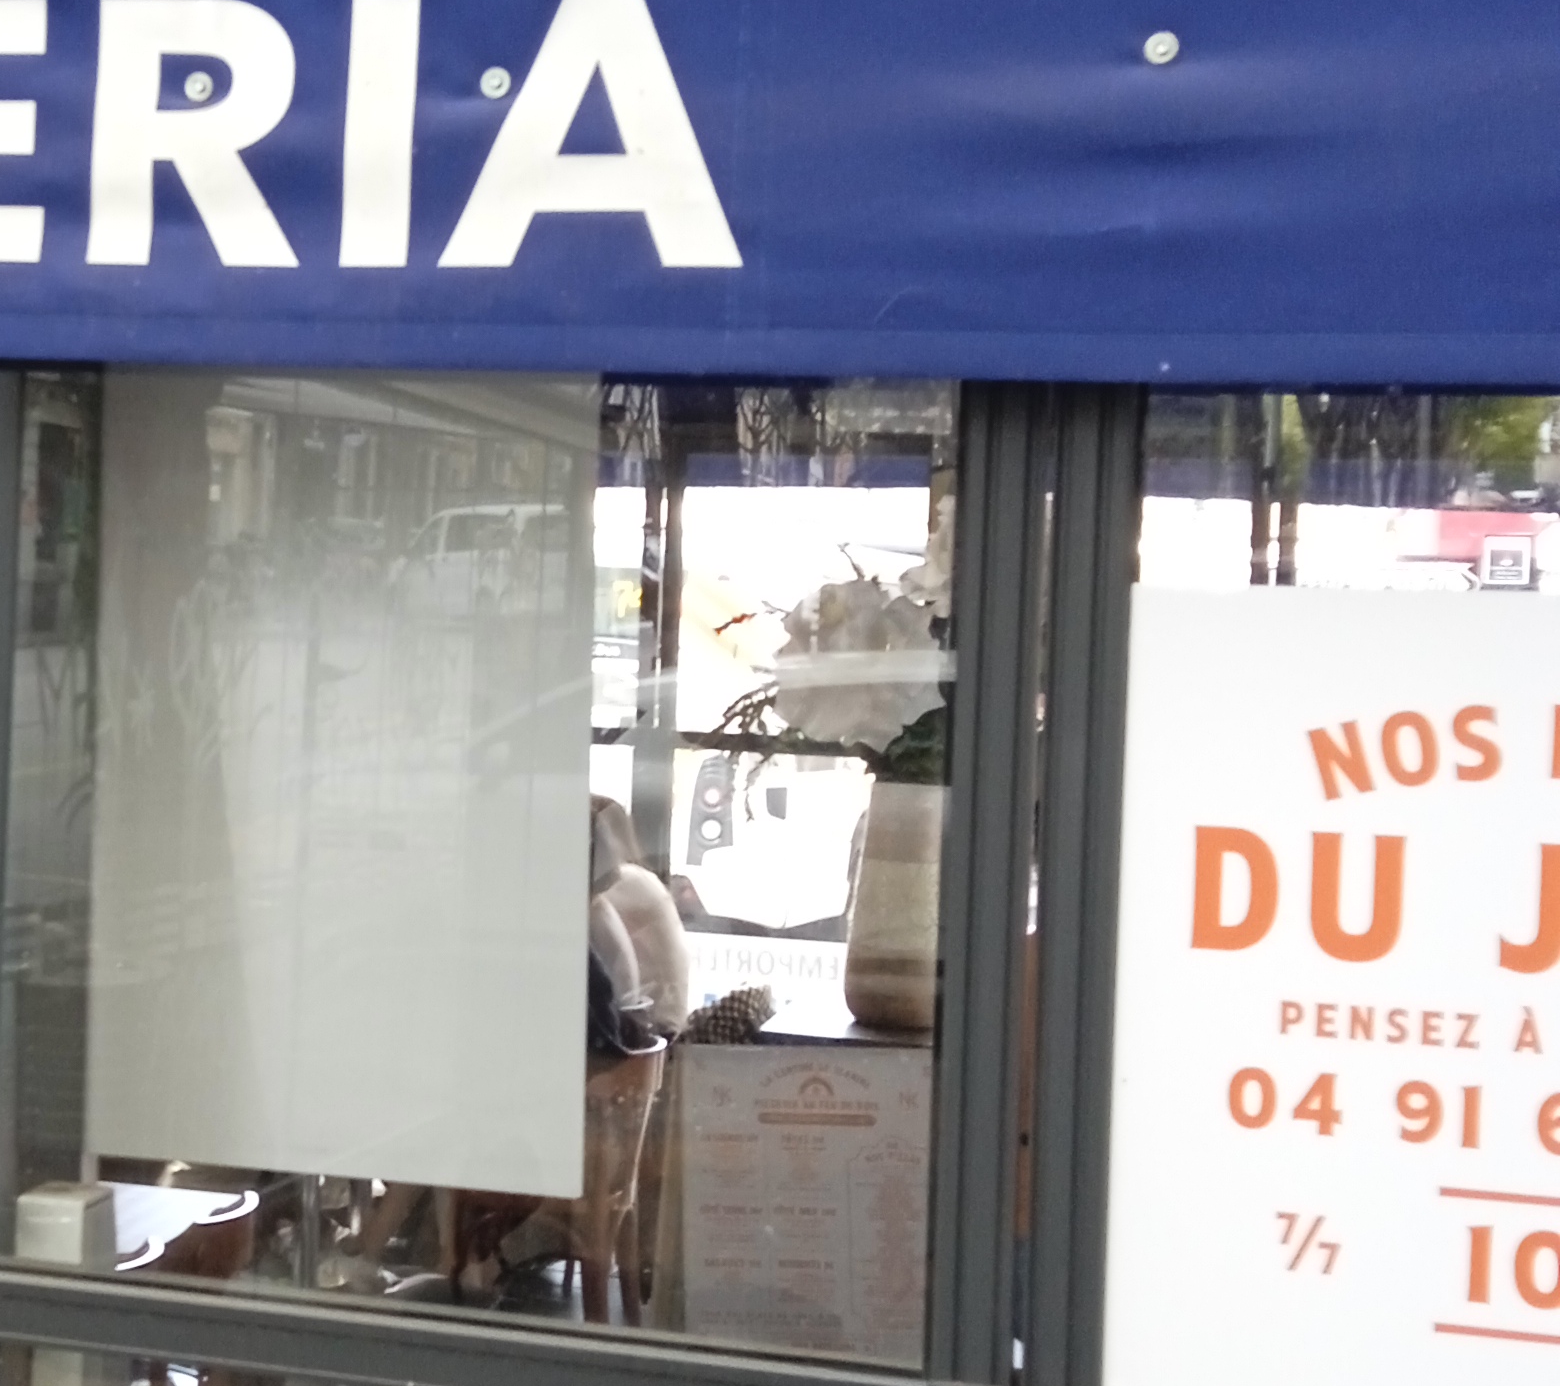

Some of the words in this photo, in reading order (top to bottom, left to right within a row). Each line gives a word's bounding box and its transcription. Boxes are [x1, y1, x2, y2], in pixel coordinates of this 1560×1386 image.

[1309, 704, 1502, 801] NOS
[1190, 825, 1407, 963] DU
[1278, 1000, 1480, 1050] PENSEZ
[1512, 1005, 1543, 1054] À
[1227, 1066, 1342, 1137] 04
[1395, 1079, 1481, 1149] 91
[1276, 1209, 1343, 1277] 7/7
